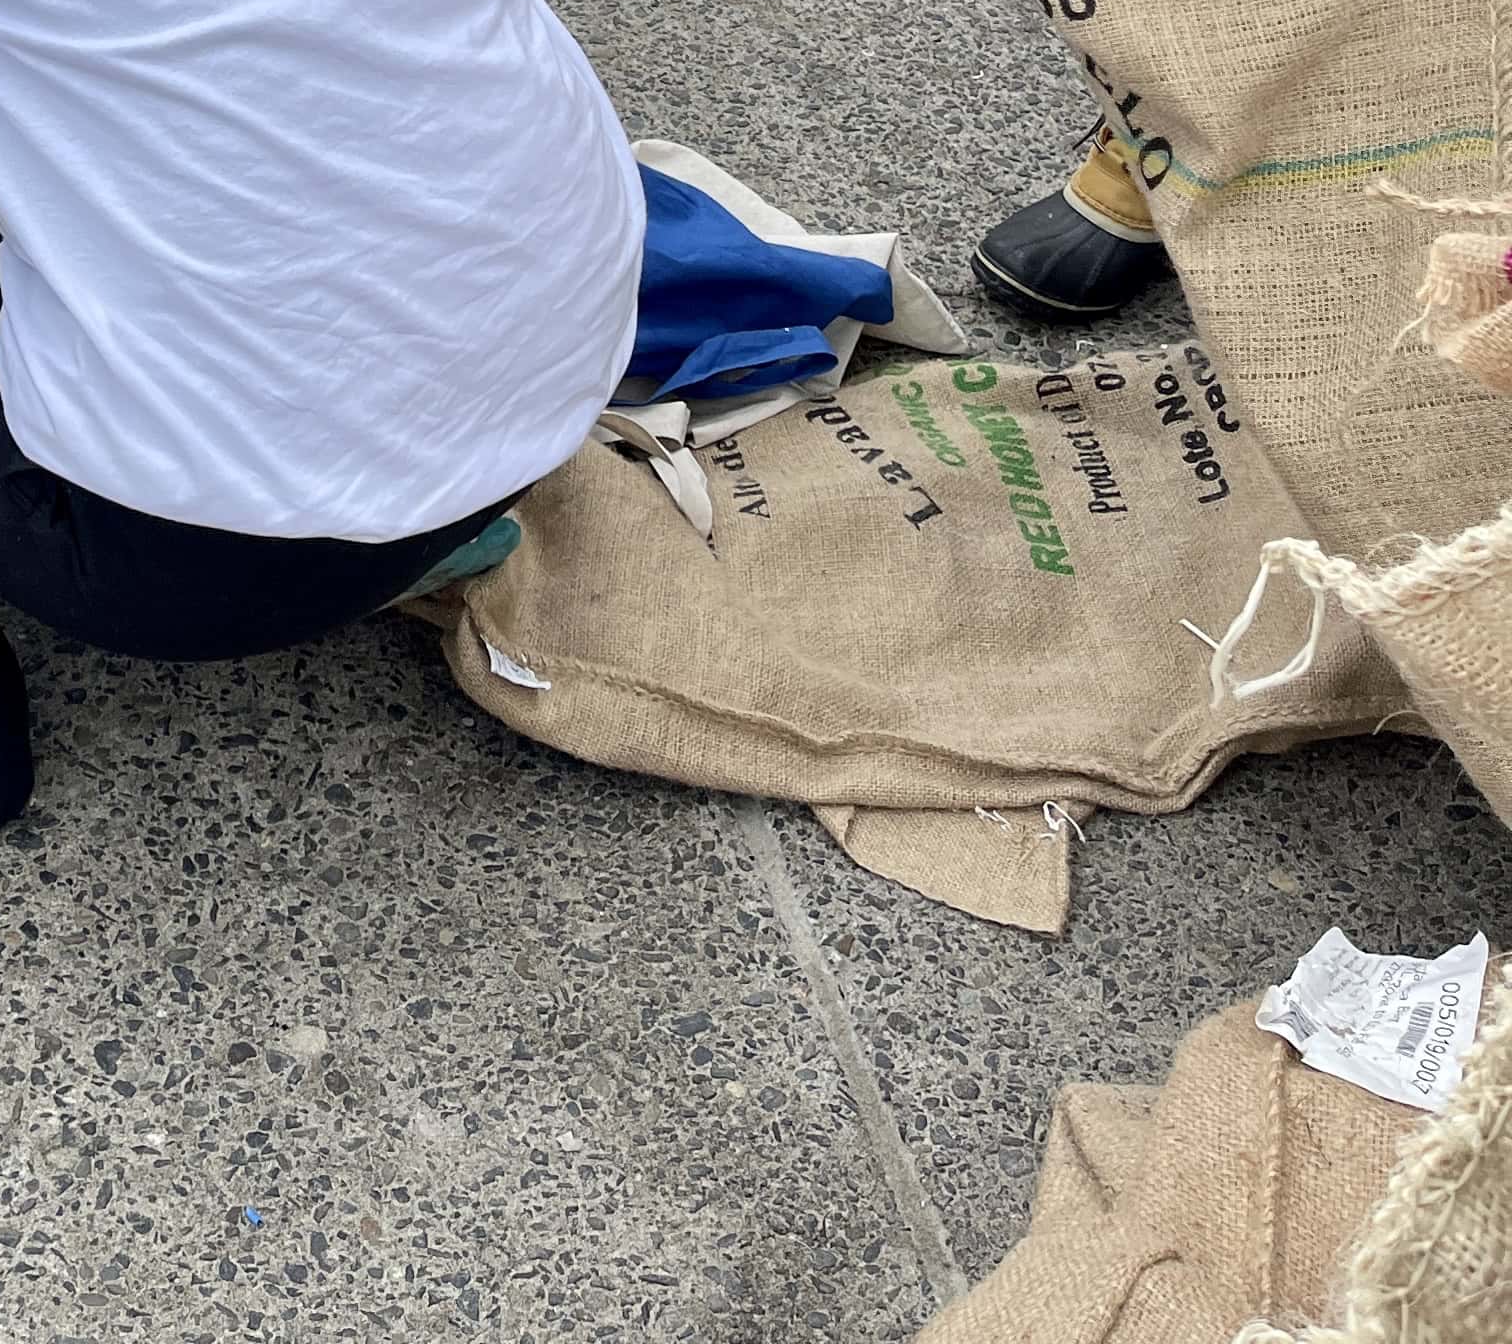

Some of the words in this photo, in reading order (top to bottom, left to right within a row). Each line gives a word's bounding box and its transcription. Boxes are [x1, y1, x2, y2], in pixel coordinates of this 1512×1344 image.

[1154, 364, 1194, 426] No.
[1063, 430, 1128, 514] Product
[1181, 429, 1231, 504] Lote
[1009, 492, 1076, 576] RED
